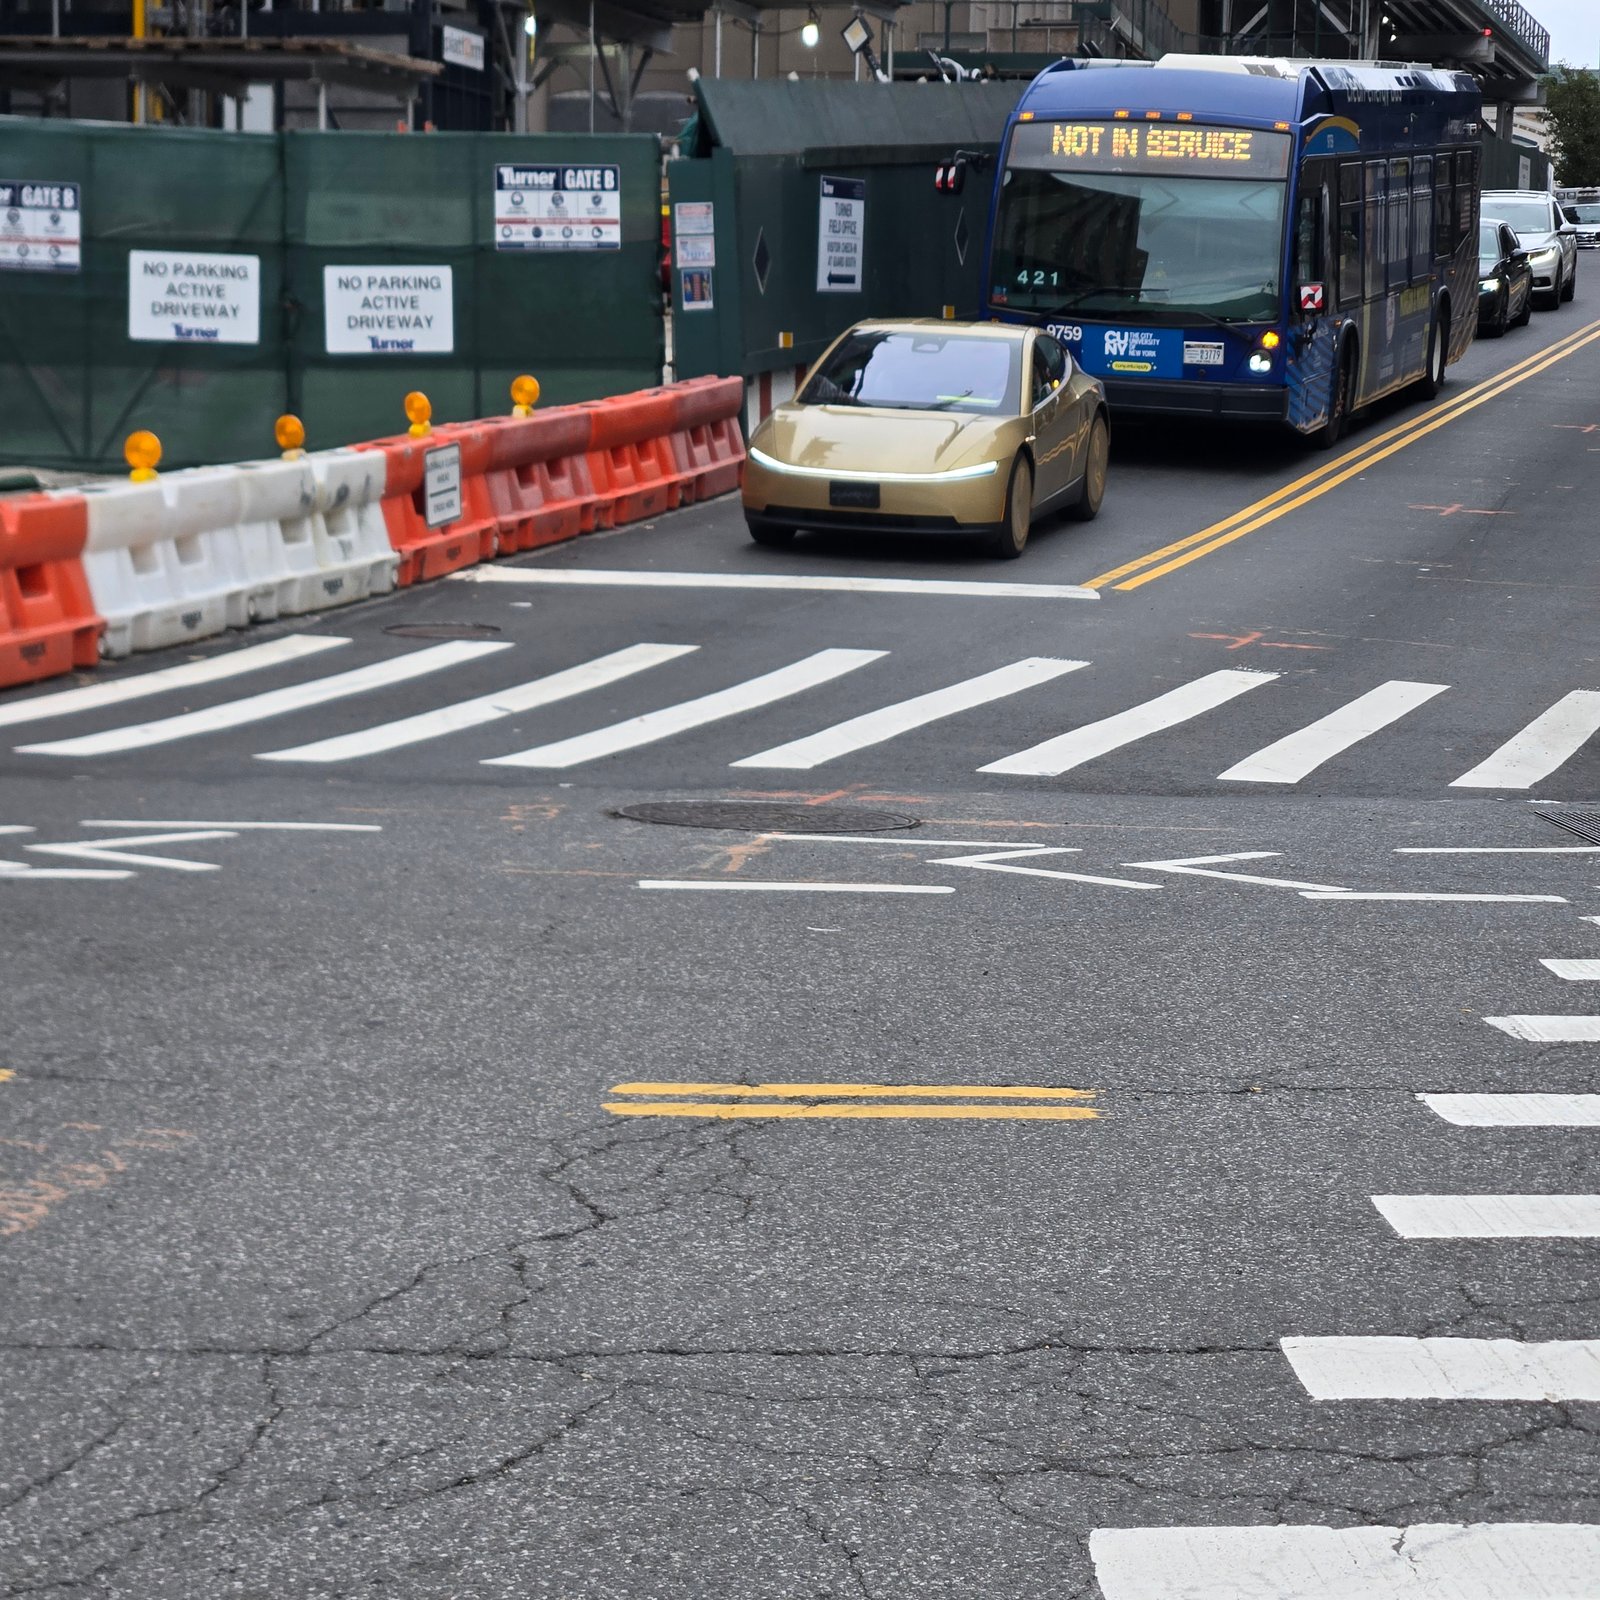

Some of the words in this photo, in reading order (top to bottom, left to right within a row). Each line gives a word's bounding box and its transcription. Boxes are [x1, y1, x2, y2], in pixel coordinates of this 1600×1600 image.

[1053, 125, 1104, 156] NOT
[1112, 128, 1138, 157] IN
[1147, 130, 1252, 159] SERVICE
[499, 166, 556, 185] Turner
[565, 169, 602, 190] GATE
[604, 170, 615, 189] B
[21, 185, 60, 208] GATE
[63, 187, 75, 208] B
[143, 261, 168, 277] NO
[173, 263, 249, 280] PARKING
[1017, 269, 1059, 286] 421
[166, 282, 226, 299] ACTIVE
[338, 275, 362, 291] NO
[367, 275, 442, 291] PARKING
[151, 301, 240, 318] DRIVEWAY
[361, 295, 420, 310] ACTIVE
[172, 322, 219, 339] Turner
[347, 314, 434, 330] DRIVEWAY
[1046, 323, 1082, 341] 9759
[1104, 330, 1129, 344] CU
[368, 335, 414, 350] Turner
[1104, 342, 1129, 356] NY
